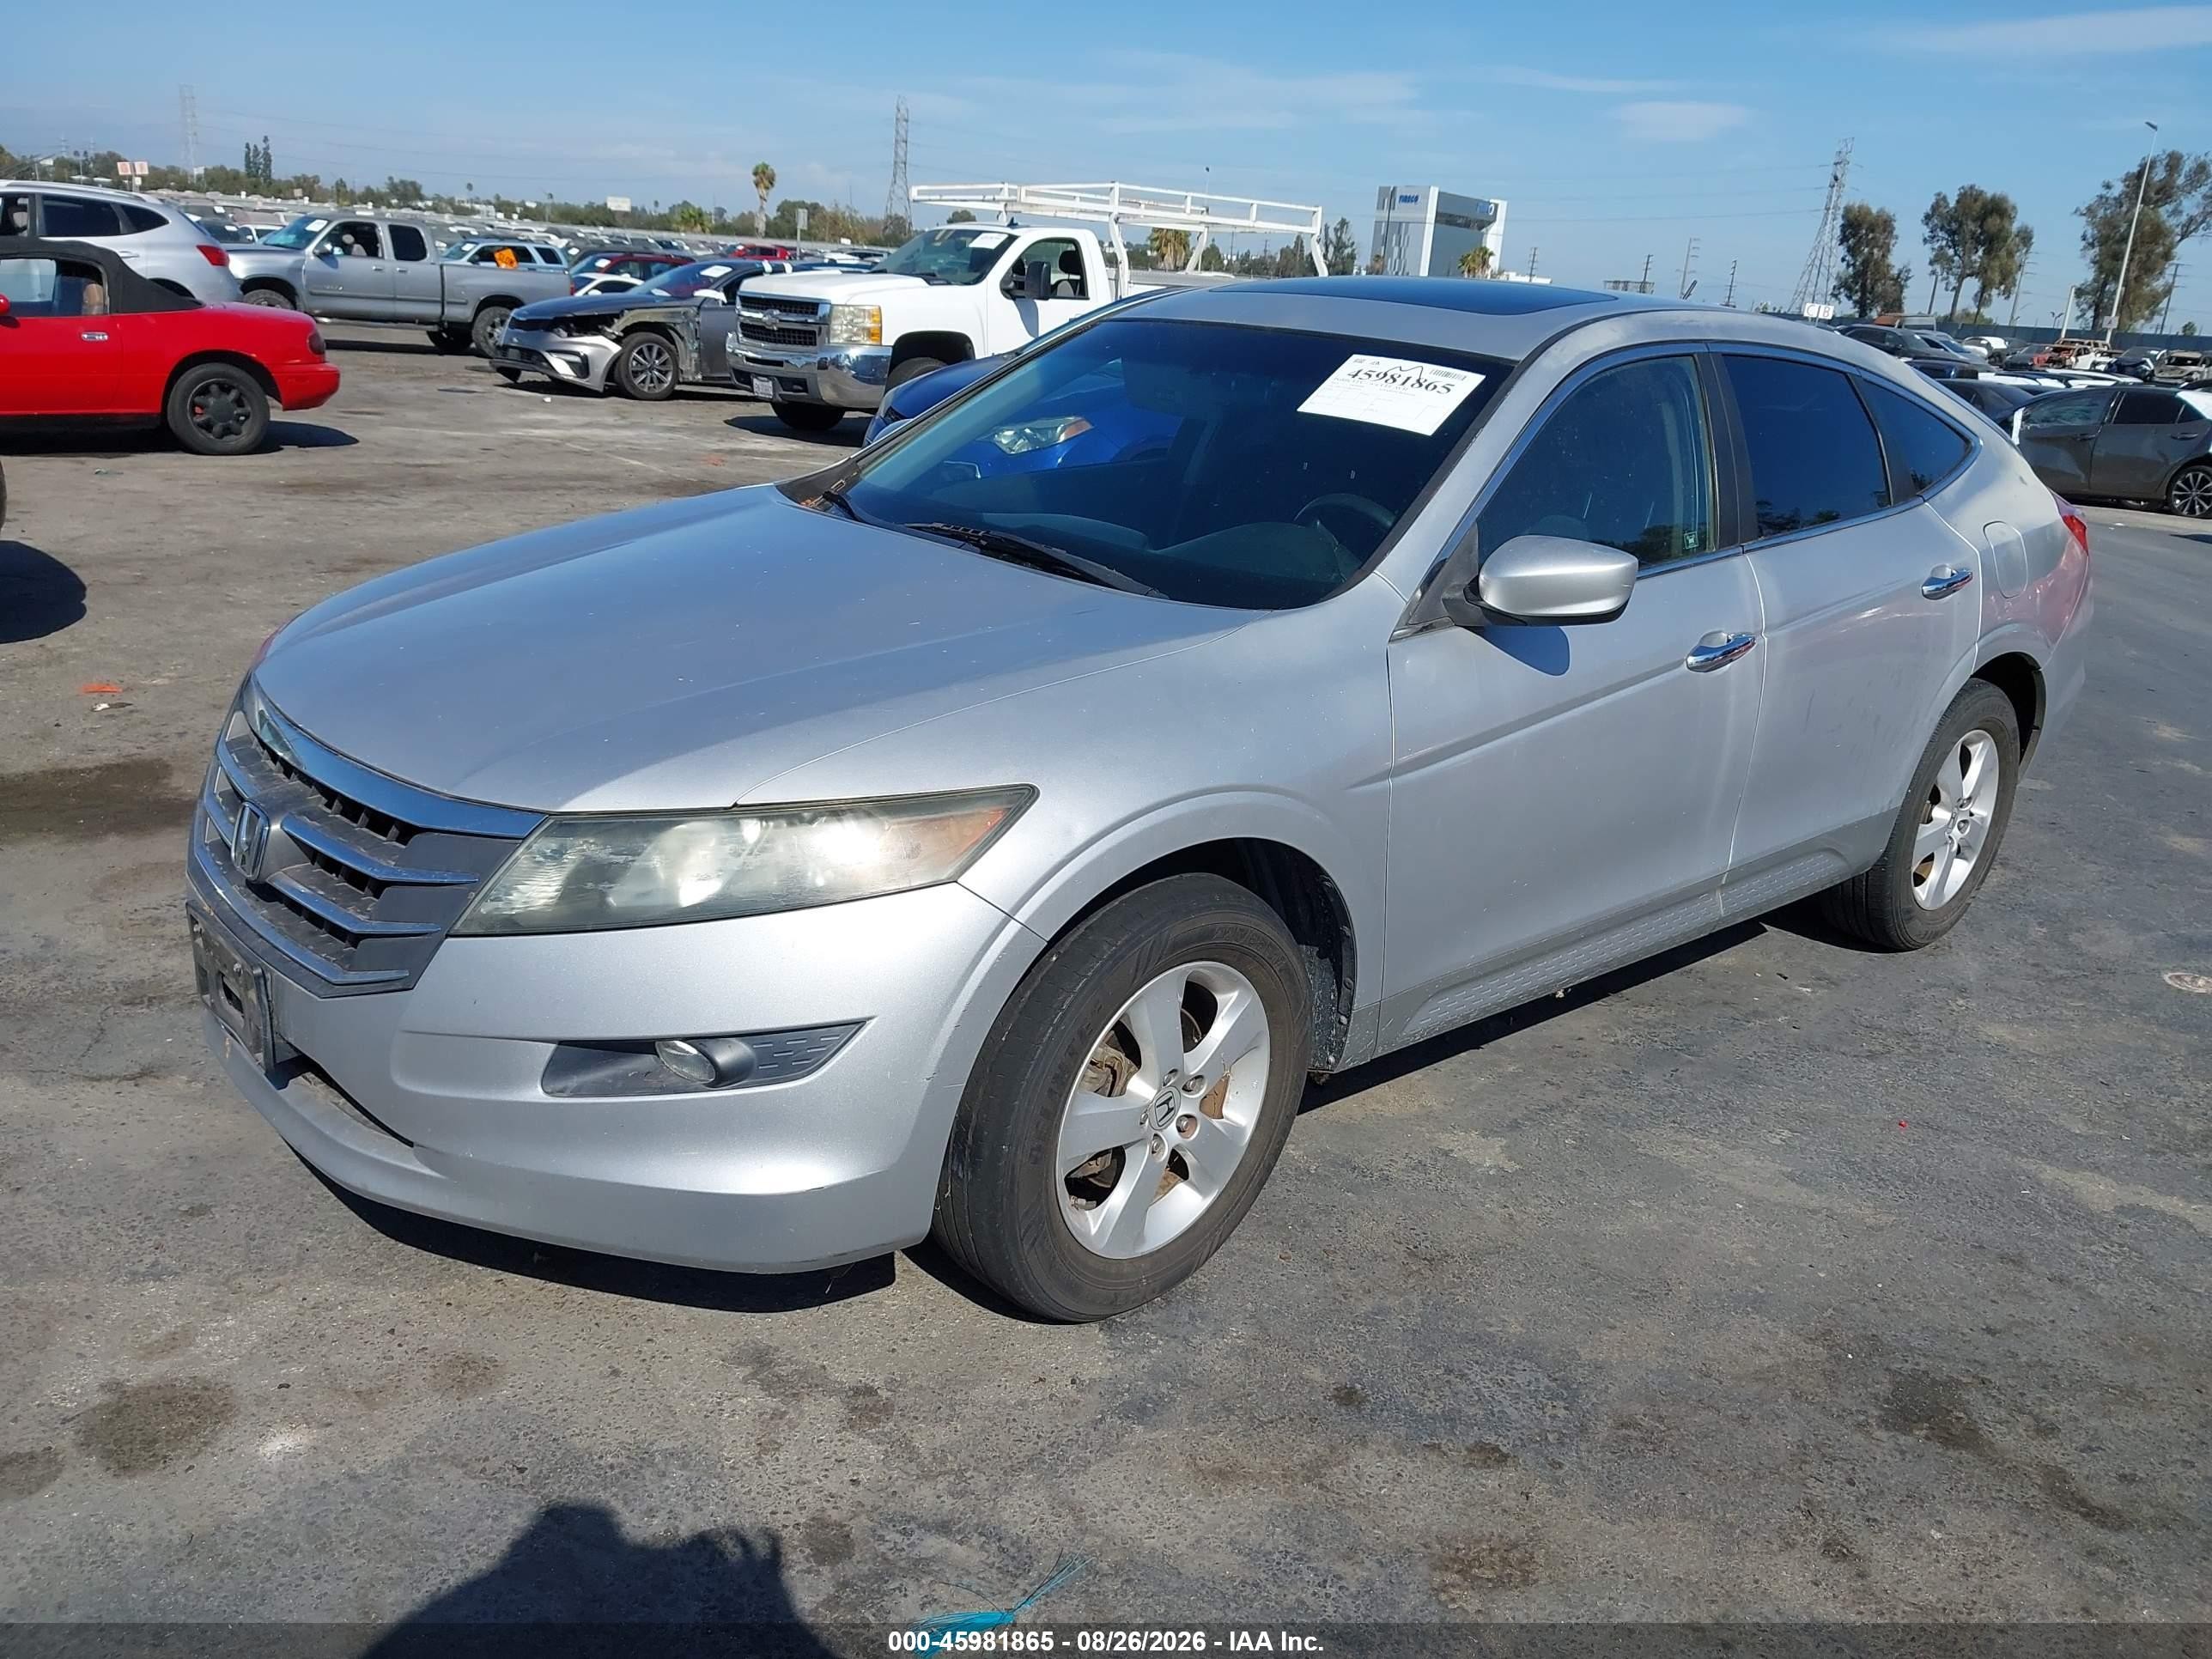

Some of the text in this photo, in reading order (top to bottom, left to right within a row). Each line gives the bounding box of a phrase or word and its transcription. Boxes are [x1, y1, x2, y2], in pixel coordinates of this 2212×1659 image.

[1806, 304, 1815, 316] C
[1822, 306, 1831, 318] B
[1347, 368, 1455, 394] 45981865
